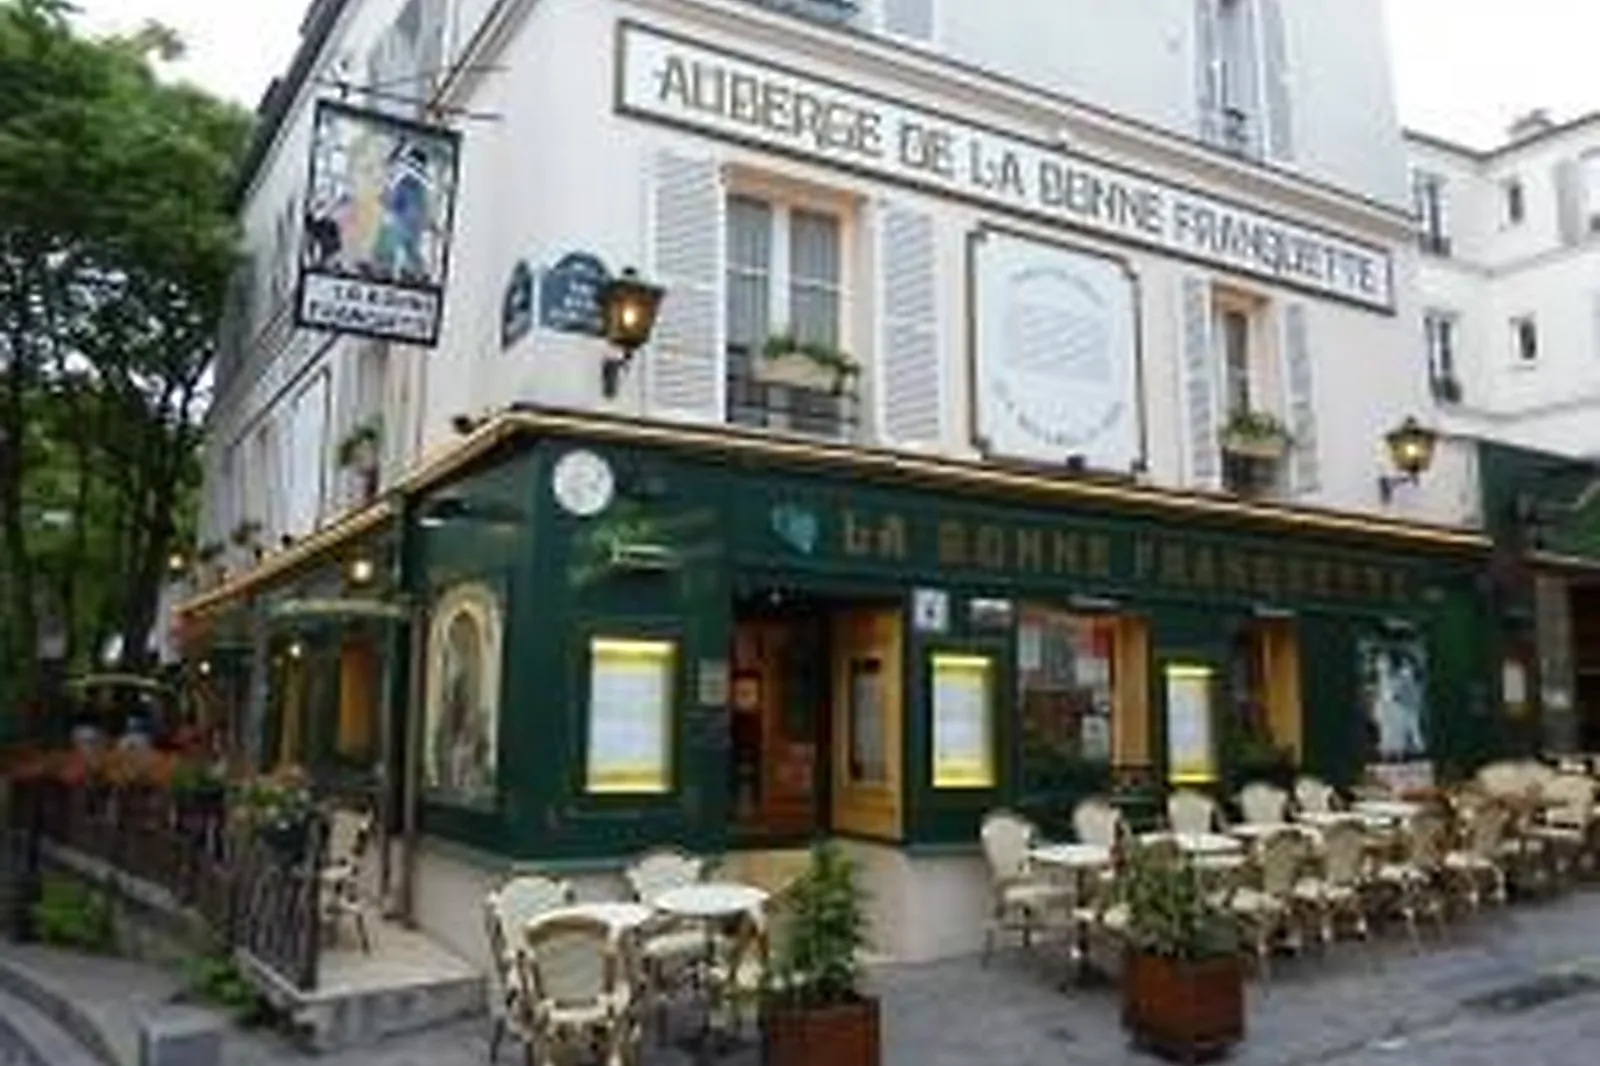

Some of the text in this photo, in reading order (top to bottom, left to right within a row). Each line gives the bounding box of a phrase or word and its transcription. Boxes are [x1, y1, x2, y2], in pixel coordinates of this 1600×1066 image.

[659, 56, 883, 158] AUBERGE
[900, 123, 956, 176] DE
[968, 138, 1025, 197] LA
[1039, 161, 1162, 234] BONNE
[845, 510, 906, 560] LA
